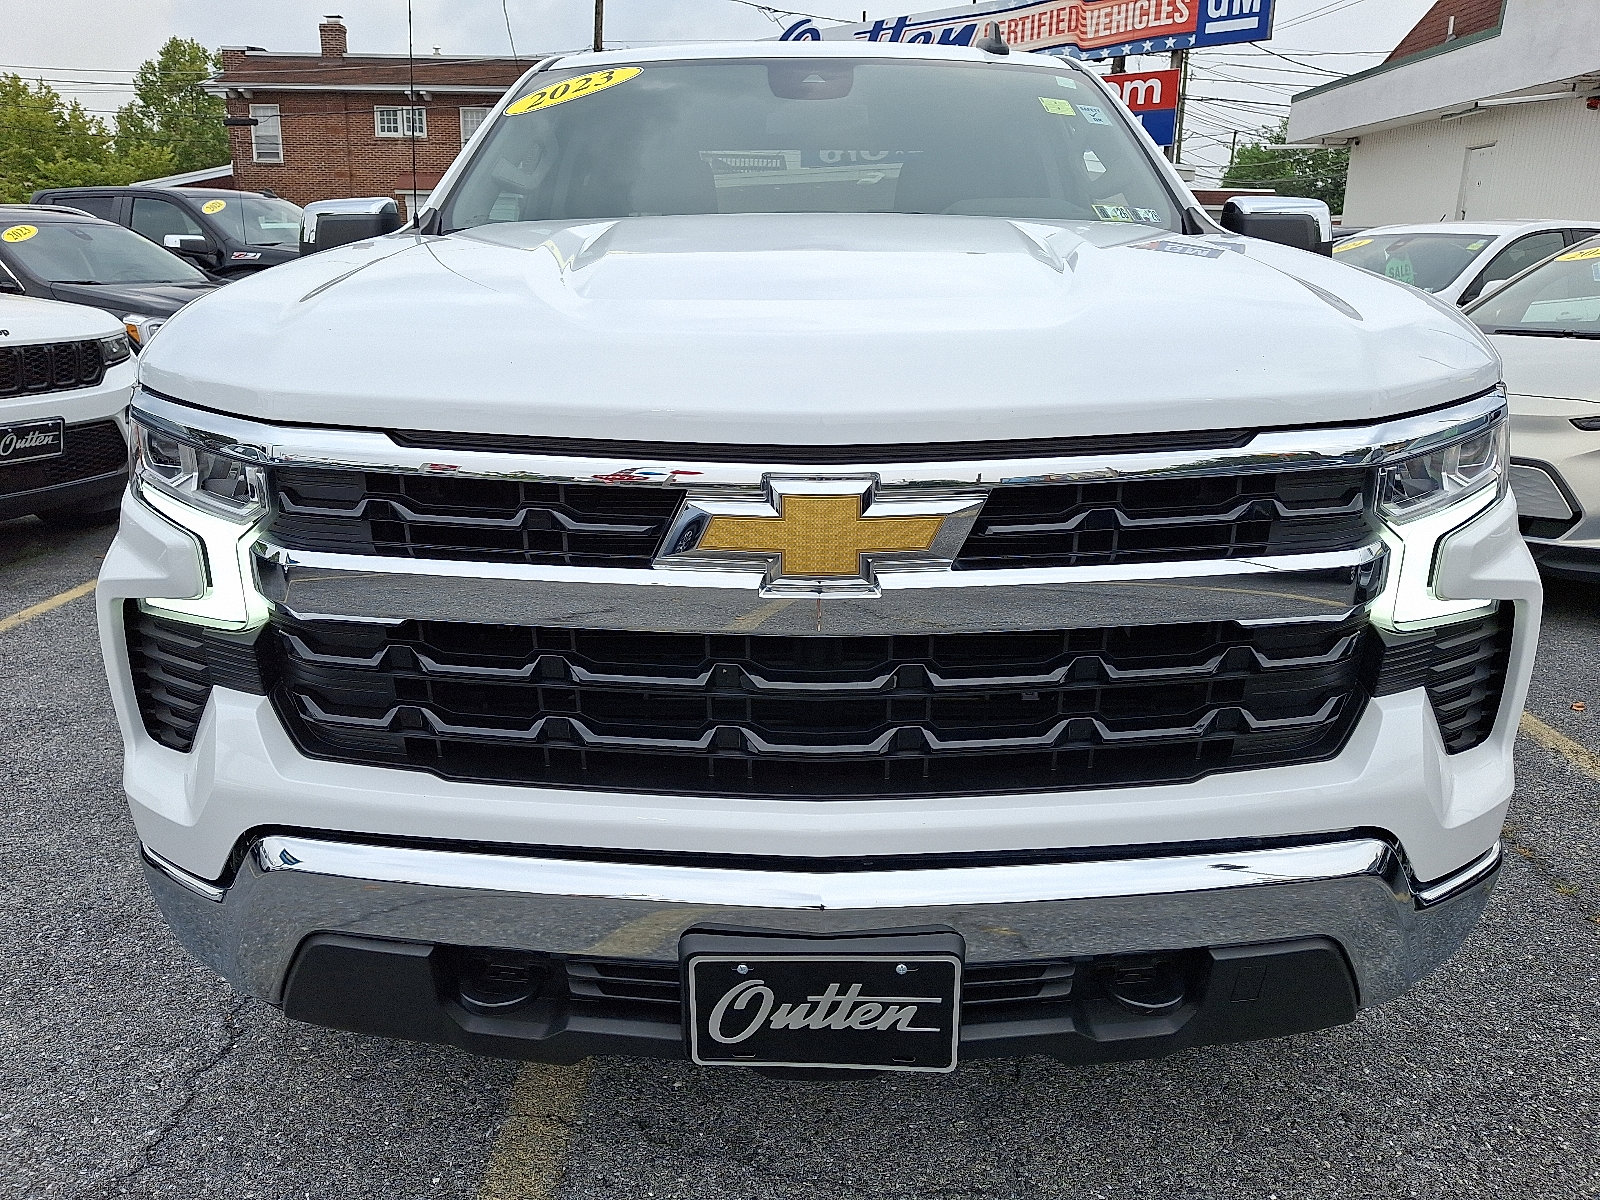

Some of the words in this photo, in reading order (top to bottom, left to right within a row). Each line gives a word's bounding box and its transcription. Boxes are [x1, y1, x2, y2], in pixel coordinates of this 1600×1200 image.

[778, 16, 978, 46] Otten
[1087, 0, 1191, 38] VEHICLES
[526, 70, 615, 110] 2023
[1106, 79, 1162, 106] m
[6, 226, 32, 242] 2023
[0, 430, 60, 456] Outten
[708, 979, 942, 1044] Outten
